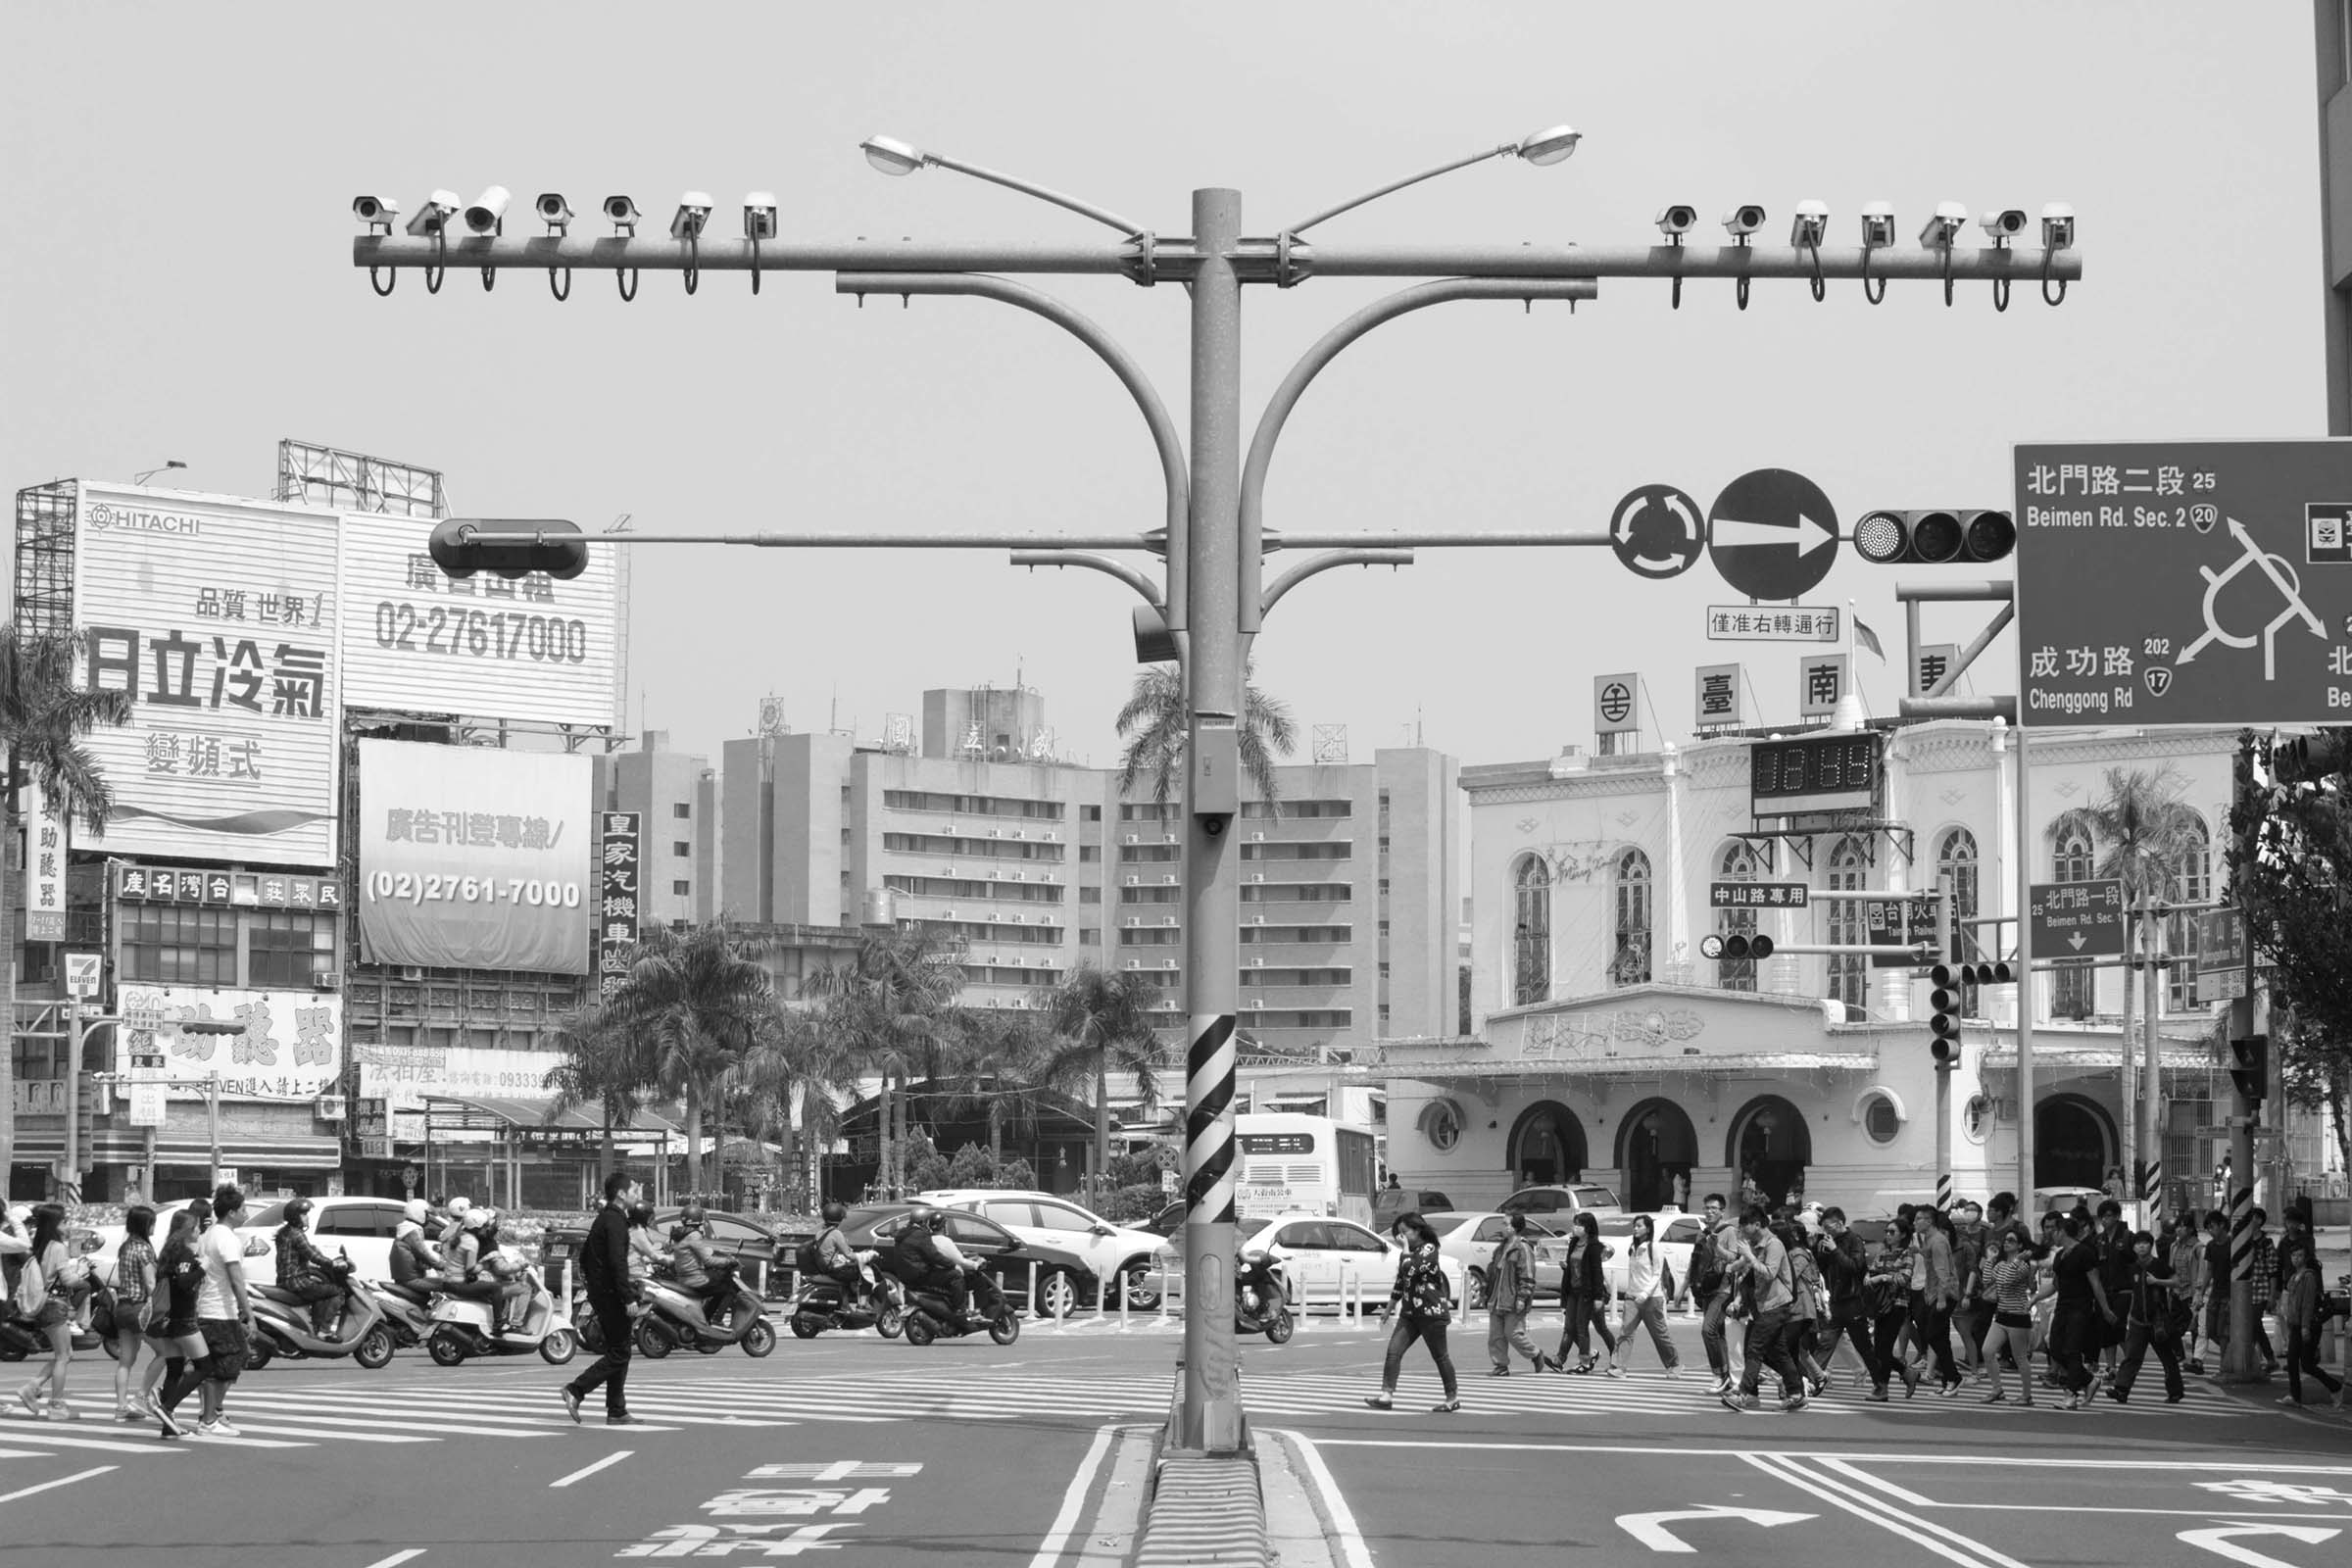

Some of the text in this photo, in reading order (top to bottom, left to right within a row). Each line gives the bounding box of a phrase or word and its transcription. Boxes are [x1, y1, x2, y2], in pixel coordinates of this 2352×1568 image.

[2028, 465, 2216, 495] 北門路二段 25
[116, 510, 201, 534] HITACHI
[2027, 505, 2213, 527] Beimen Rd. Sec. 2 20
[196, 587, 247, 619] 品質
[376, 601, 586, 663] 02-27617000
[1711, 612, 1835, 635] 僅准右轉通行
[2030, 645, 2134, 677] 成功路
[2144, 639, 2170, 655] 202
[88, 625, 326, 717] 日立冷氣
[2148, 673, 2168, 687] 17
[2030, 687, 2108, 713] Chenggong
[2115, 687, 2132, 708] Rd
[146, 732, 262, 780] 變頻式
[366, 869, 581, 908] (02)2761-7000
[1714, 887, 1804, 905] 中山路專用
[2032, 886, 2121, 916] 25 北門路一段
[2046, 916, 2076, 928] Beimen
[172, 1002, 335, 1067] 助聽器
